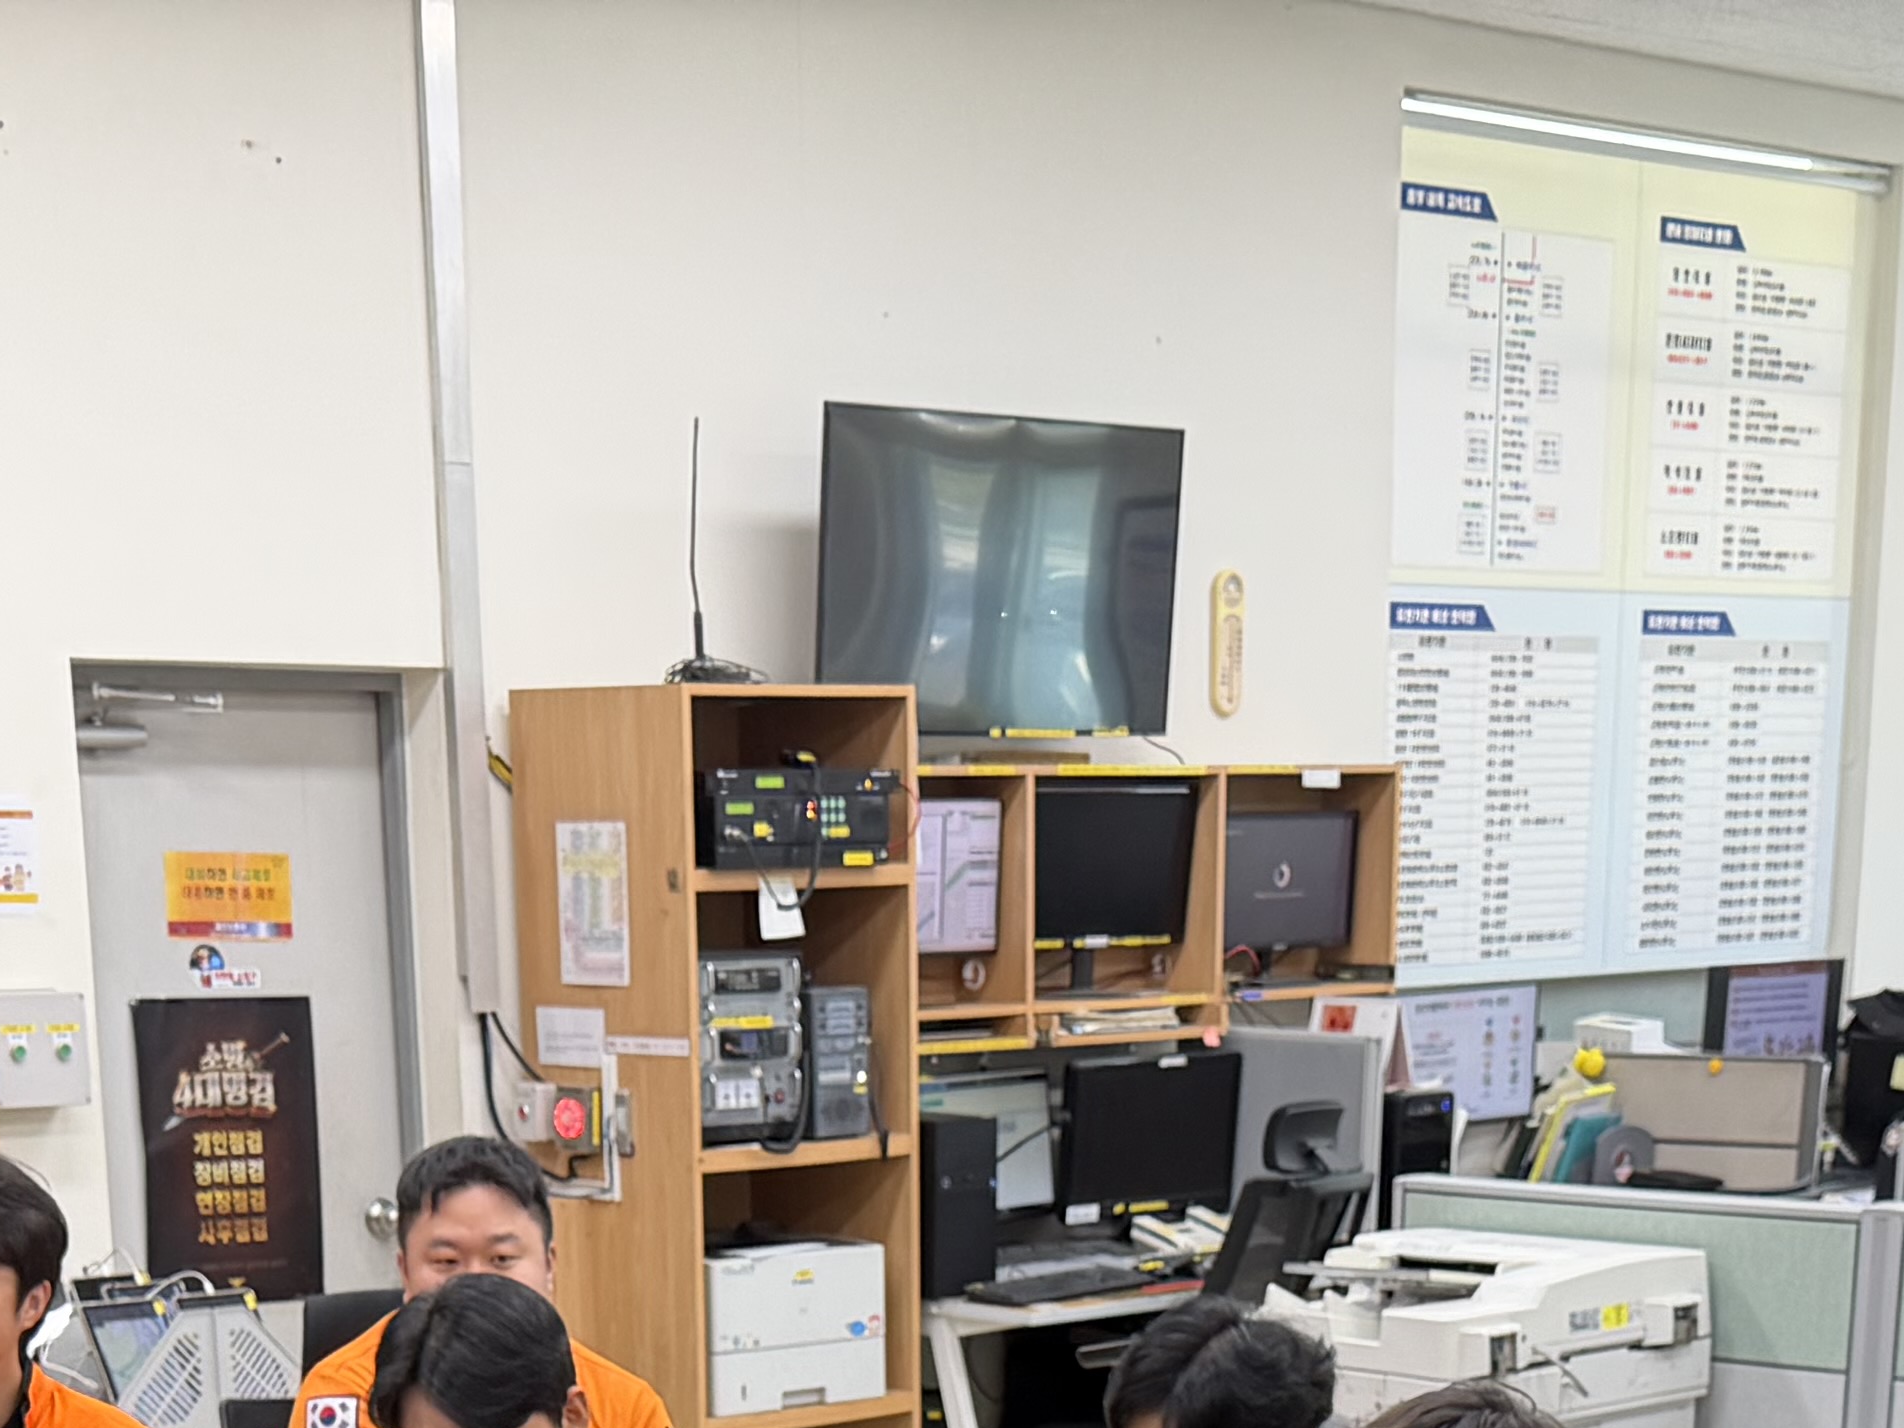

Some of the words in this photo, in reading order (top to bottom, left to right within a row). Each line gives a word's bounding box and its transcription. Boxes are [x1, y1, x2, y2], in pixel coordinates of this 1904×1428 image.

[199, 1040, 247, 1071] 소방
[193, 1130, 264, 1156] 개인점검
[193, 1158, 265, 1186] 장비점검
